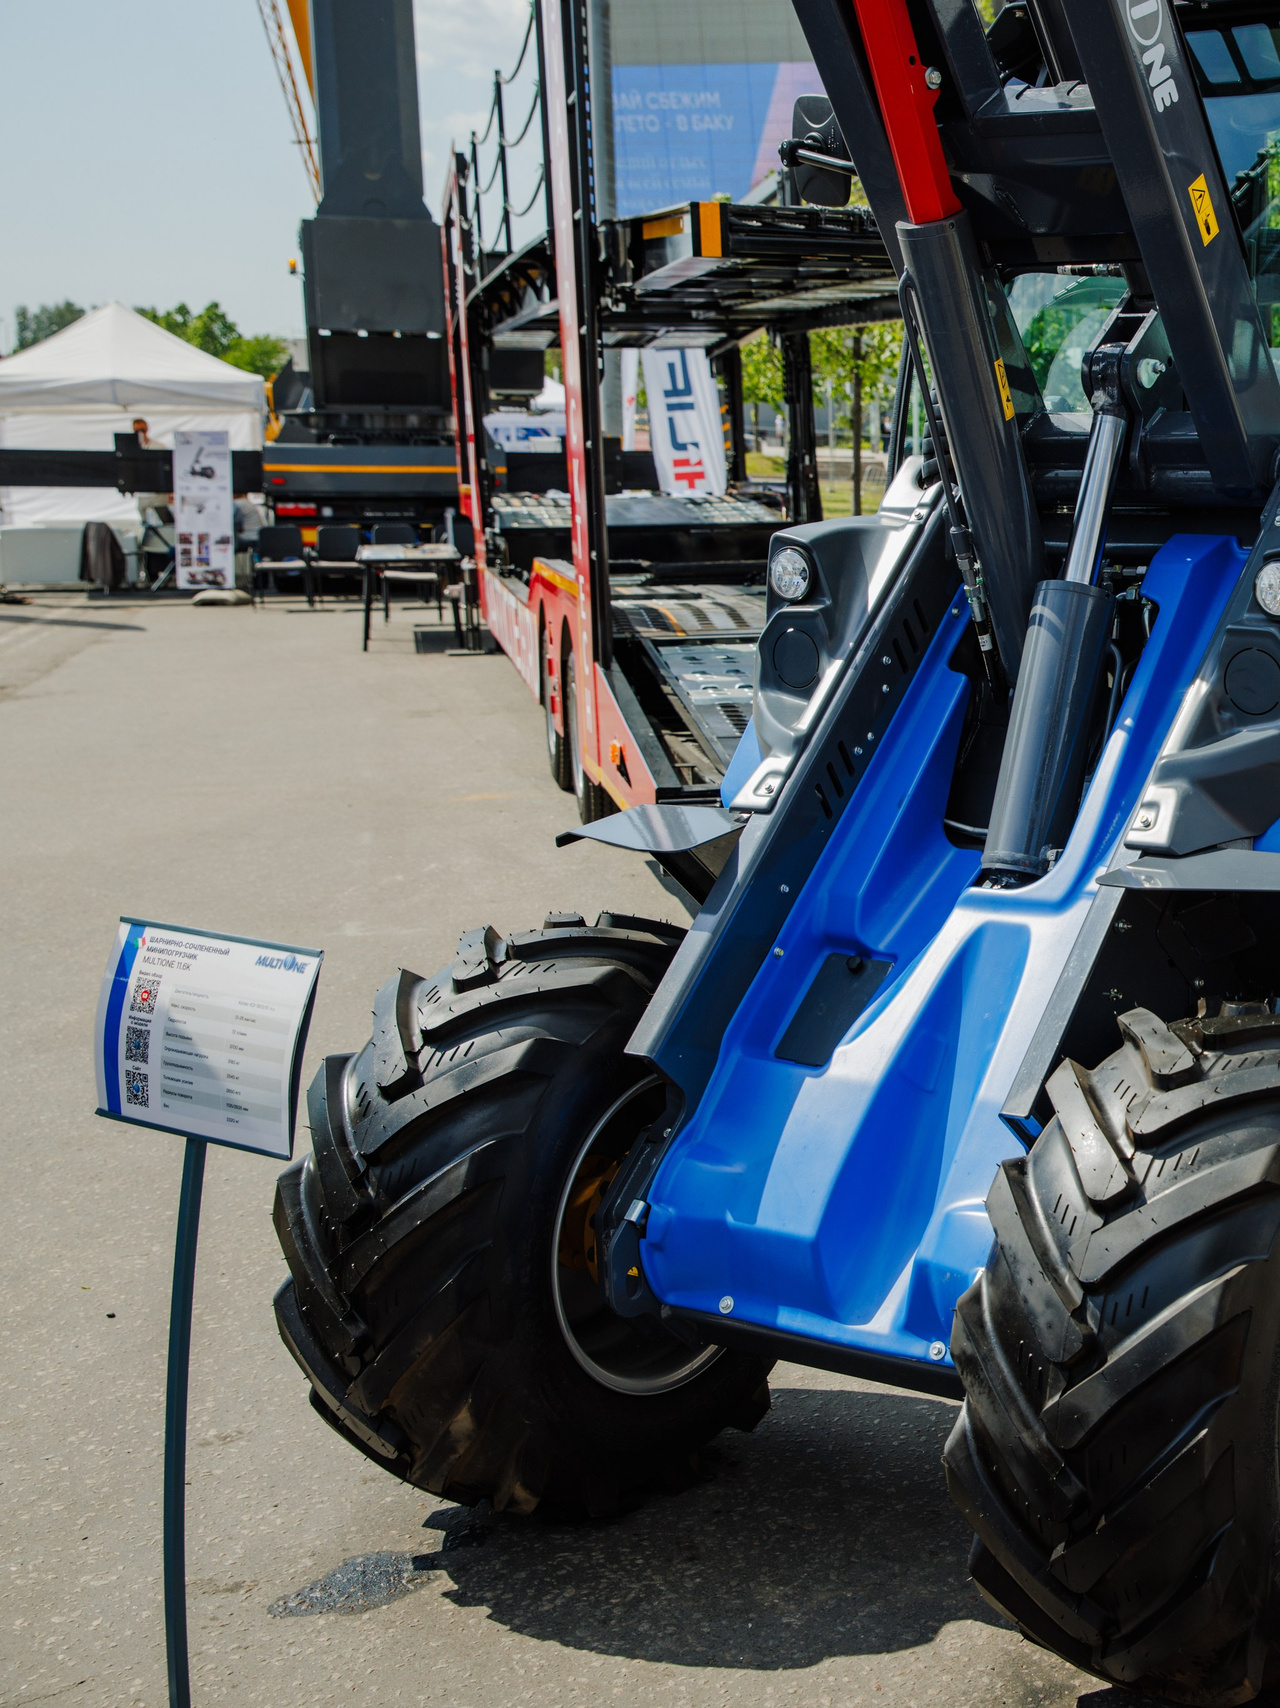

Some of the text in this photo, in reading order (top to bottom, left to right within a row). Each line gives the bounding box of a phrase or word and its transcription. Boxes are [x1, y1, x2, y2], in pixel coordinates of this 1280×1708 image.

[646, 91, 721, 110] СБЕЖИМ
[692, 114, 735, 131] БАКУ
[146, 946, 198, 960] МИНИПОГРУЗЧИК
[149, 936, 230, 956] ШАРНИРНО-СОЧЛЕНЕННЫЙ
[142, 956, 175, 969] MULTIONE
